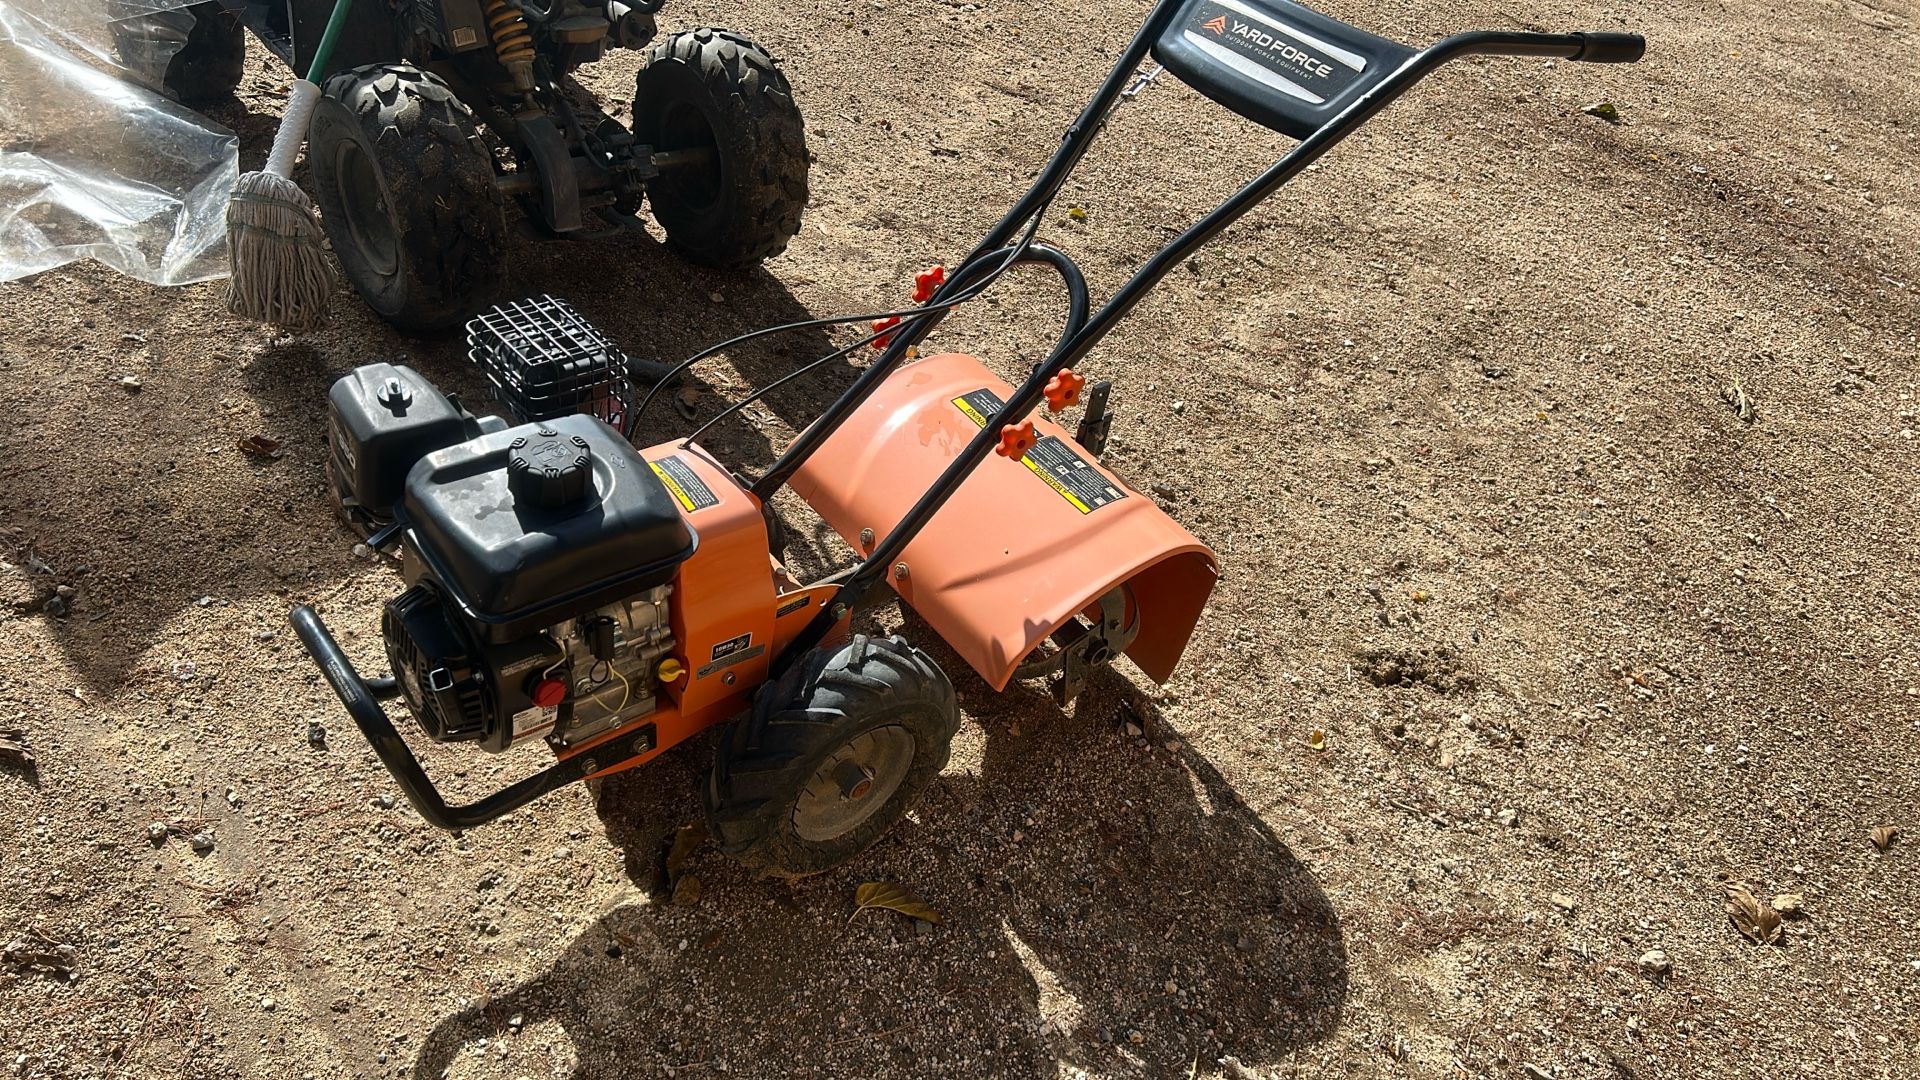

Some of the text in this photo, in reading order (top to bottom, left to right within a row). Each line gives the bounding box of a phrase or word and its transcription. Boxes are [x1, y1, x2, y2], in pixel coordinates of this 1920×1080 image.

[1225, 33, 1313, 80] OUTDOOR POWER EQUIPMENT
[1230, 20, 1334, 78] YARD FORCE
[965, 408, 986, 426] RNING
[1034, 467, 1063, 492] WARNING
